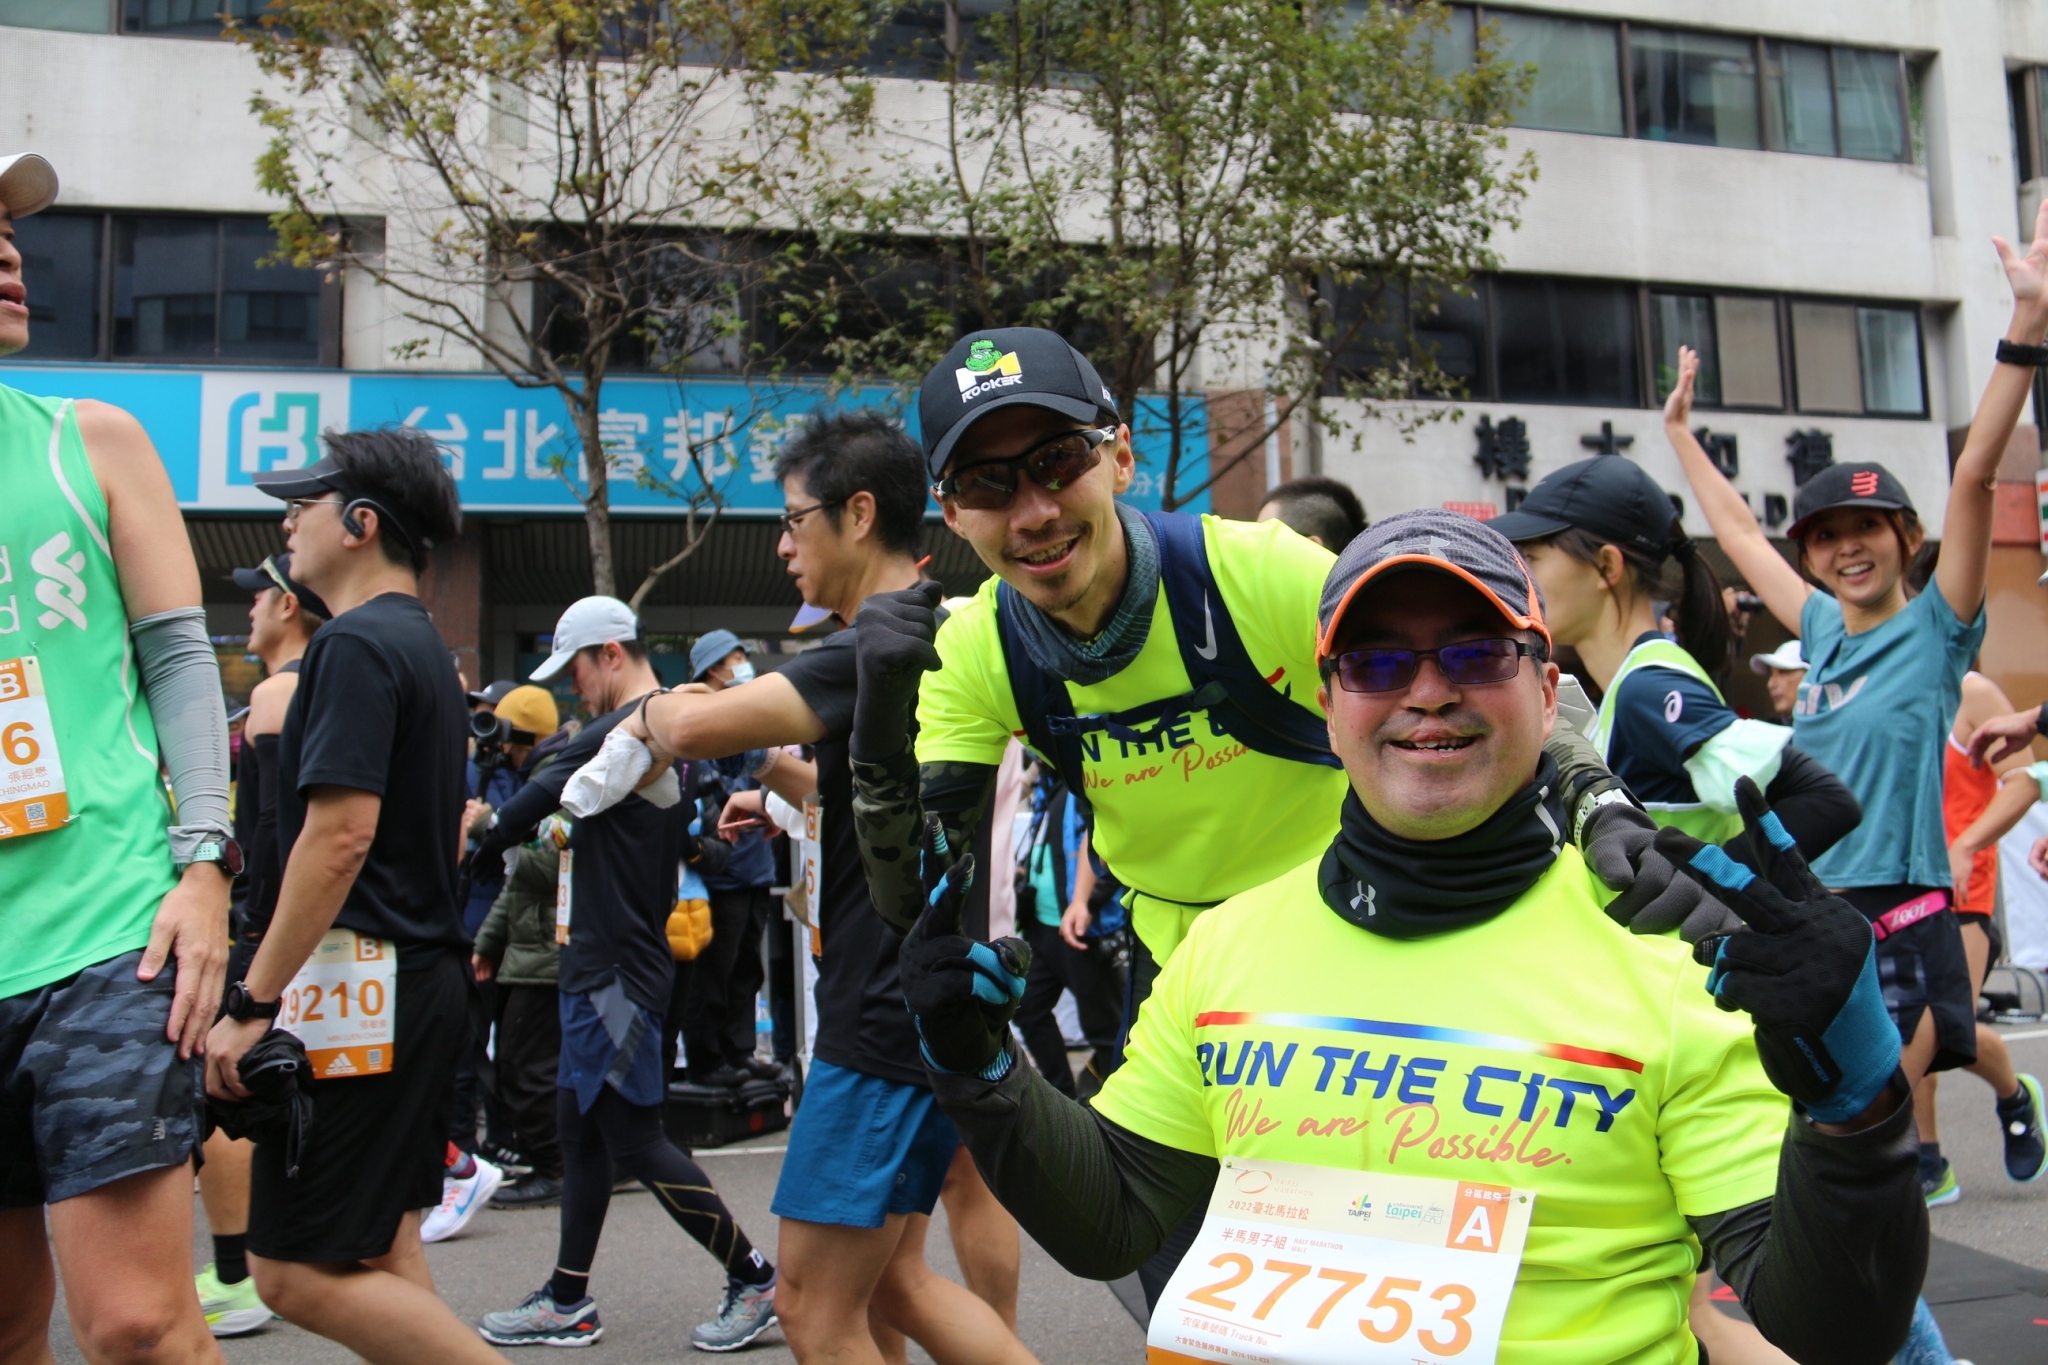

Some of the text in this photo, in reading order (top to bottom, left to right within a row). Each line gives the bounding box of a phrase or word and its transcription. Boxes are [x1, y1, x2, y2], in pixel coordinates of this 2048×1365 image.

[961, 373, 1023, 403] ROOKER
[1082, 768, 1114, 790] We
[1125, 764, 1164, 785] are
[360, 937, 379, 959] B
[1196, 1040, 1636, 1133] RUN THE CITY
[1224, 1087, 1572, 1169] We are Possible.
[1273, 1186, 1314, 1197] MARATHON
[1275, 1178, 1300, 1187] TAIPEI
[1347, 1208, 1372, 1219] TAIPEI
[1385, 1202, 1422, 1220] taipei
[1453, 1204, 1494, 1248] A
[1221, 1227, 1288, 1250] 半馬男子組
[1290, 1245, 1308, 1254] MALE
[1293, 1237, 1344, 1251] HALF MARATHON
[1185, 1251, 1477, 1357] 27753
[1230, 1328, 1254, 1343] Truck
[1255, 1336, 1269, 1347] No.
